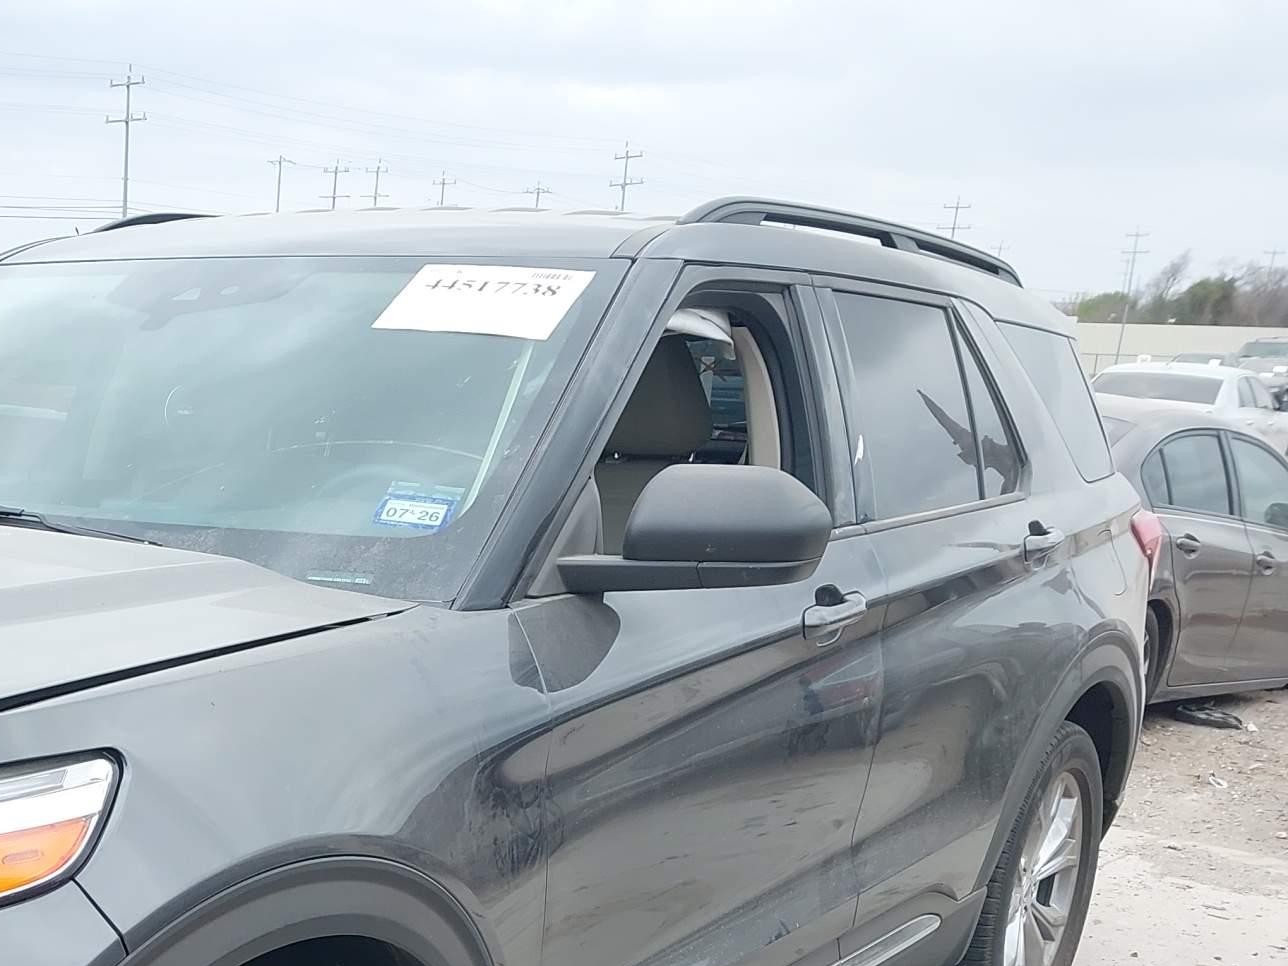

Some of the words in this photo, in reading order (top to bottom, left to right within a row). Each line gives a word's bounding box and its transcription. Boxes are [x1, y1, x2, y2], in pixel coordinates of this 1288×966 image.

[425, 279, 561, 297] 44517738
[386, 507, 409, 519] 07
[417, 510, 441, 523] 26
